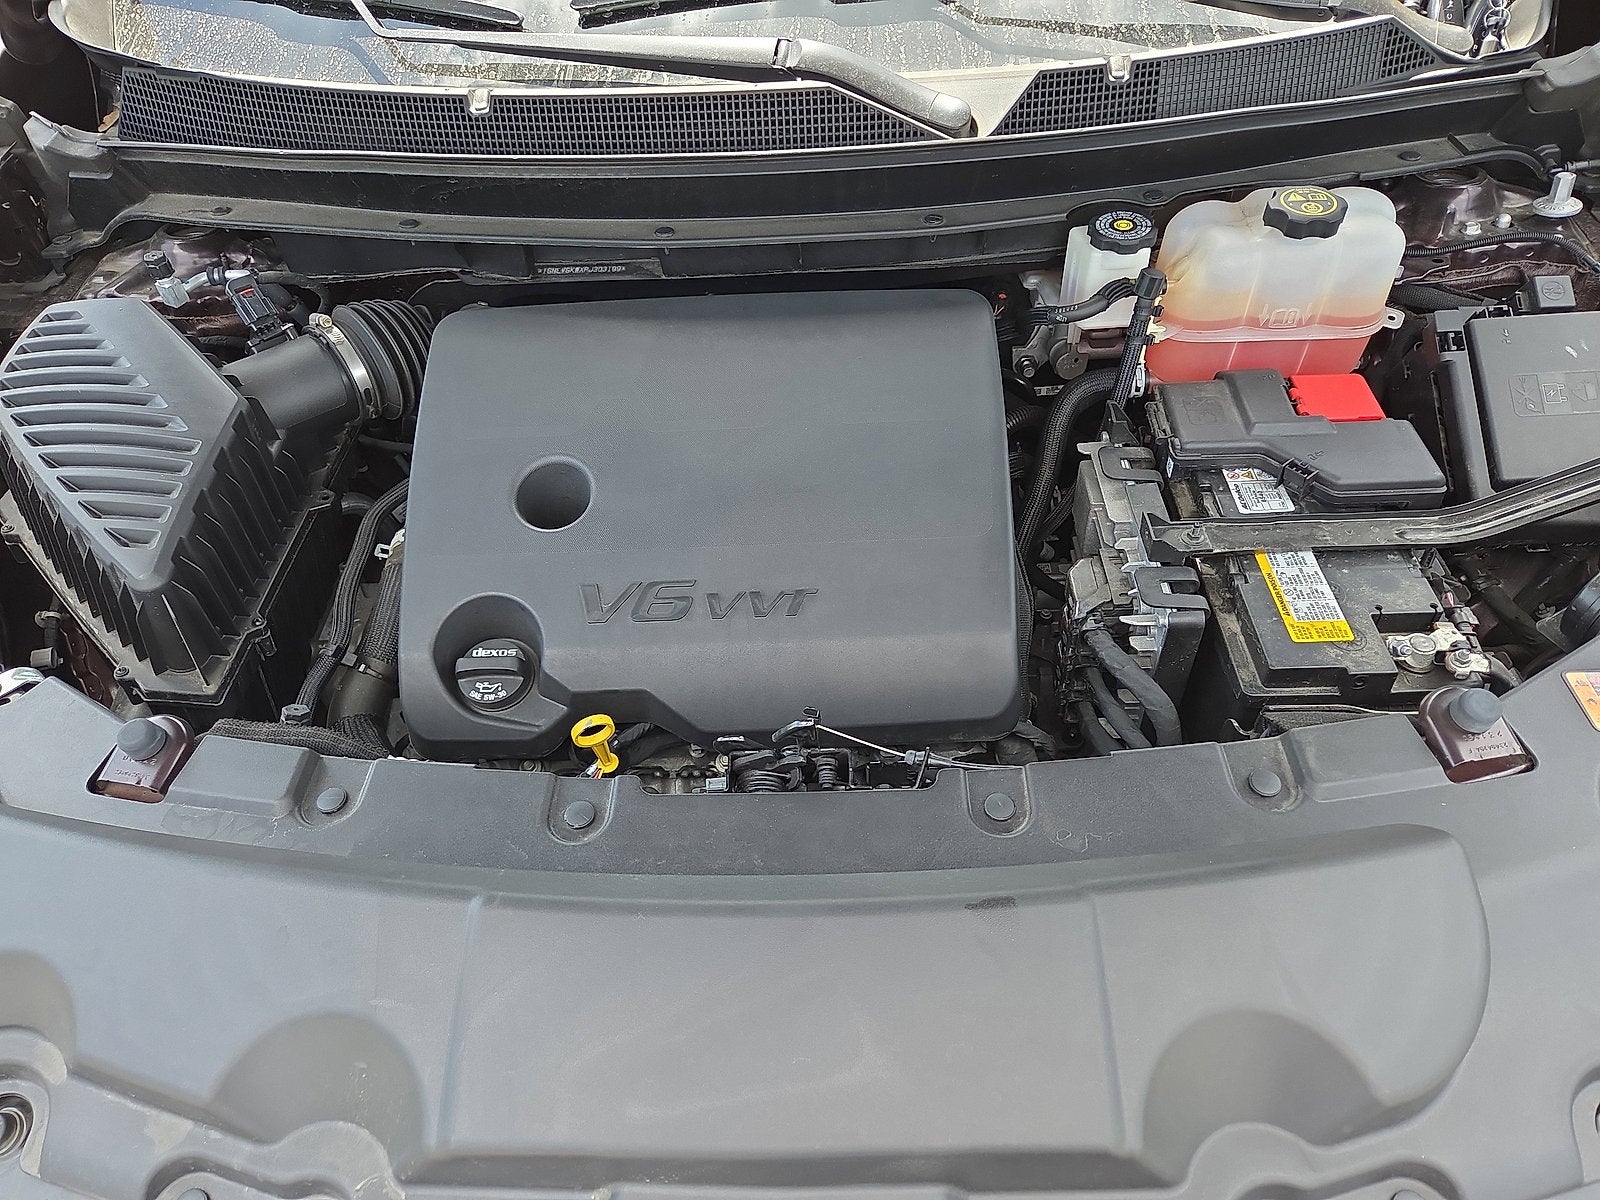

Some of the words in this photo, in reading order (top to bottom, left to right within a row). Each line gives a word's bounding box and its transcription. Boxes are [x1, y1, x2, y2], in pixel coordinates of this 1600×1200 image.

[579, 579, 698, 625] V6
[704, 588, 819, 620] VVT
[471, 647, 519, 658] dexos
[468, 690, 483, 700] SAE
[483, 689, 508, 701] 5W-30
